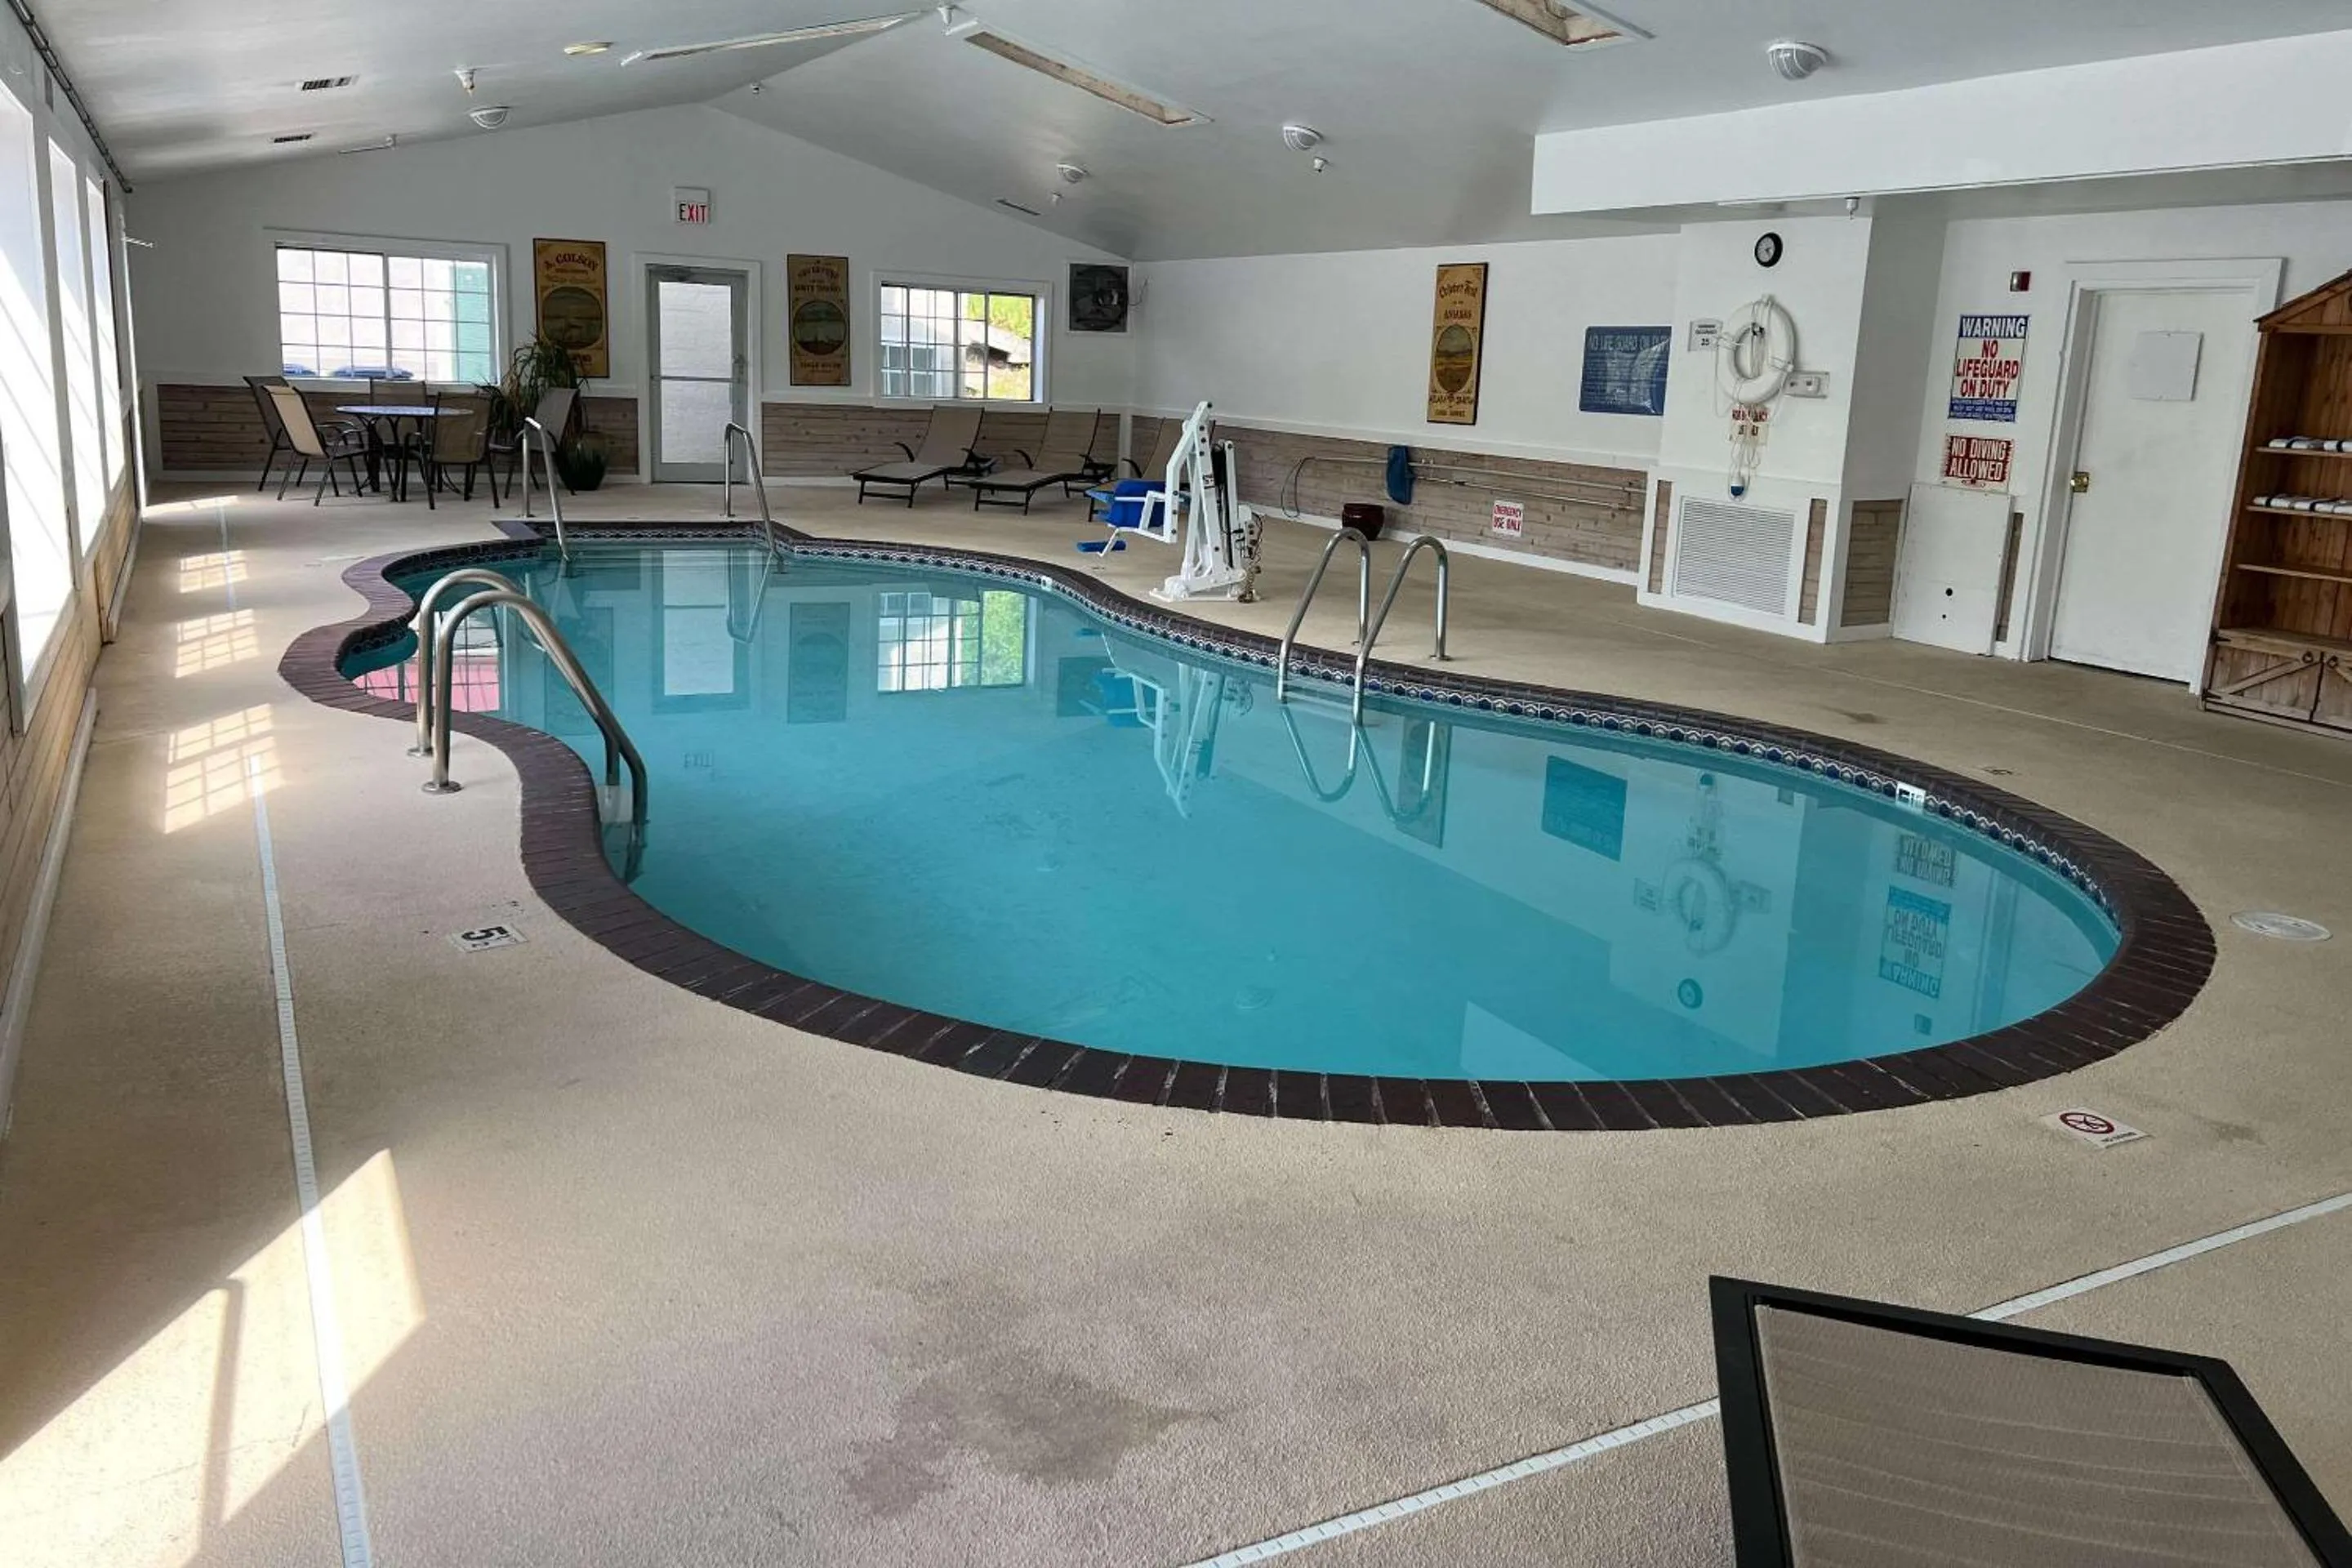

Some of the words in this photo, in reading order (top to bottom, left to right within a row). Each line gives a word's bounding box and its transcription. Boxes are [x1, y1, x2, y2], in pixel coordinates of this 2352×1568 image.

[679, 203, 707, 223] EXIT
[1961, 317, 2025, 337] WARNING
[1981, 340, 1998, 359] NO
[1956, 359, 2019, 379] LIFEGUARD
[1961, 379, 1976, 397] ON
[1980, 380, 2010, 399] DUTY
[1951, 439, 1967, 457] NO
[1971, 439, 2007, 460] DIVING
[1949, 458, 2002, 480] ALLOWED
[461, 926, 508, 941] 5
